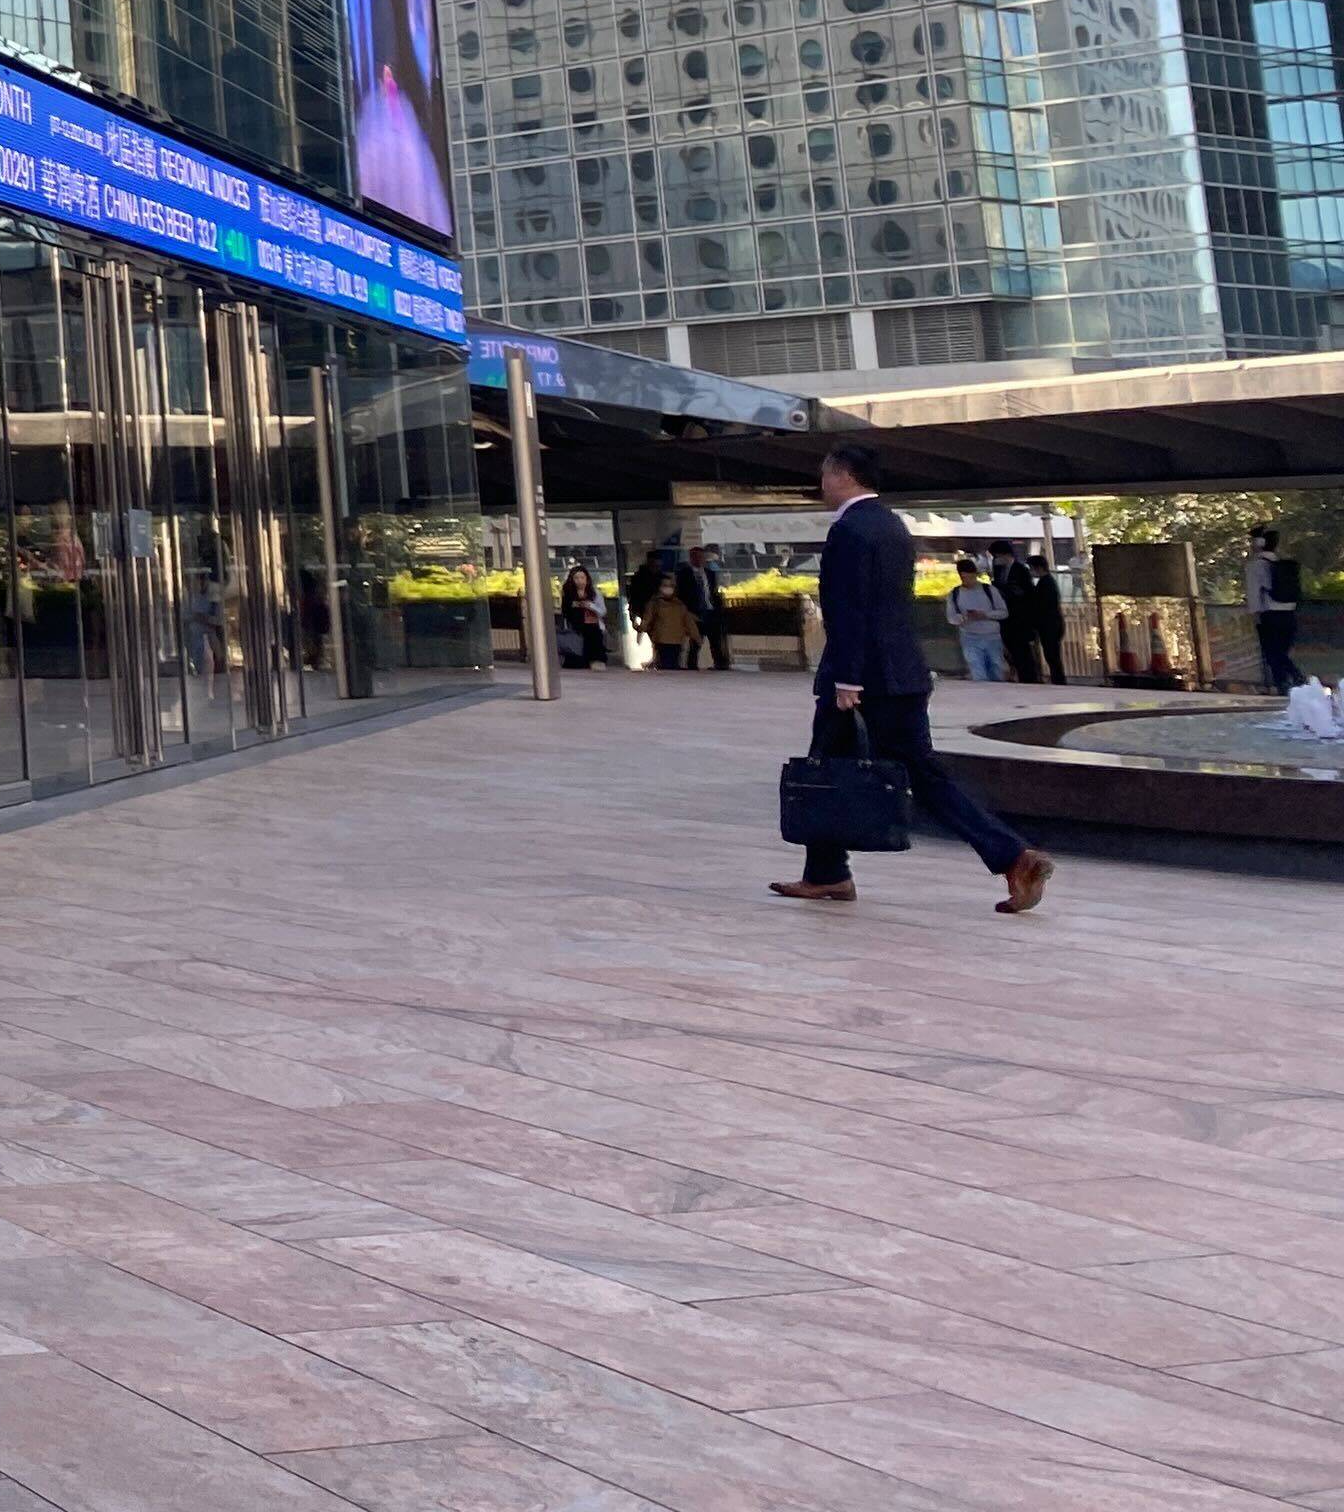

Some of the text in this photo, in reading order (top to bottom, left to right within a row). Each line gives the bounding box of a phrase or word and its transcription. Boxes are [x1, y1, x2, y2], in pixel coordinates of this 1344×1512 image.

[160, 146, 213, 197] REGIONAL
[104, 184, 141, 225] CHINA
[141, 197, 165, 235] RES
[165, 205, 195, 245] BEER
